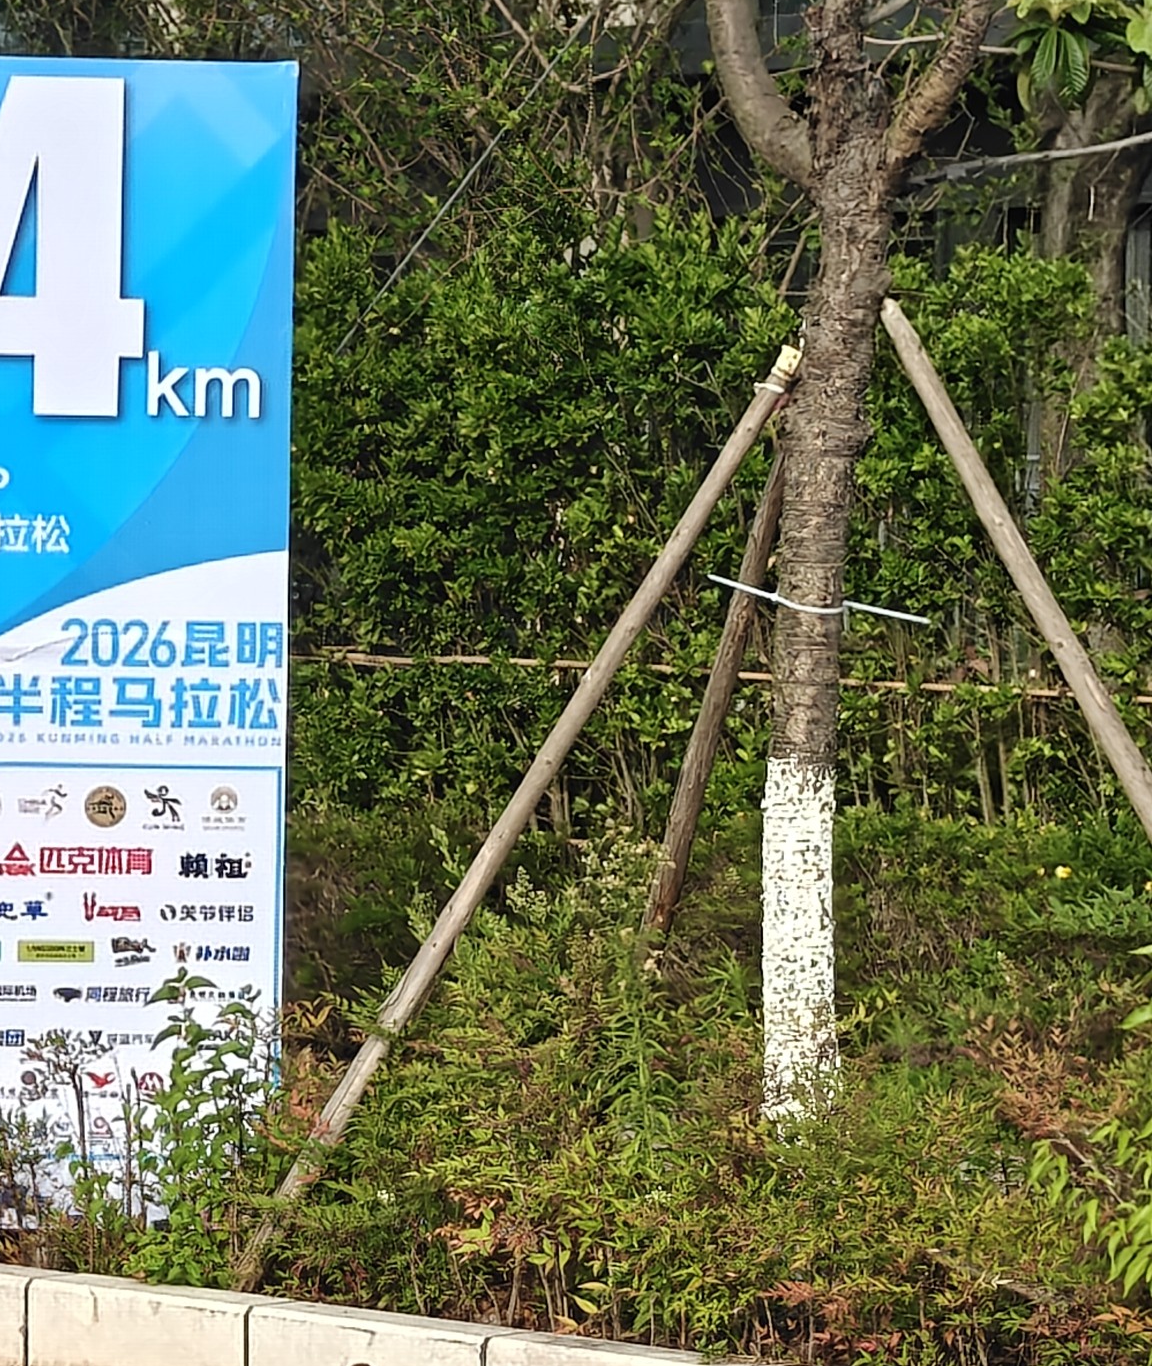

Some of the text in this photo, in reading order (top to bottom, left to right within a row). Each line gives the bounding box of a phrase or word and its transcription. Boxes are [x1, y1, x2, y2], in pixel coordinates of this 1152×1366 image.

[148, 350, 261, 418] km
[60, 618, 283, 668] 2026昆明
[36, 732, 120, 745] KUNMING
[129, 734, 173, 745] HALF
[183, 734, 282, 747] MARATHON
[39, 846, 153, 875] 匹克体育
[85, 986, 150, 1003] 同程旅行
